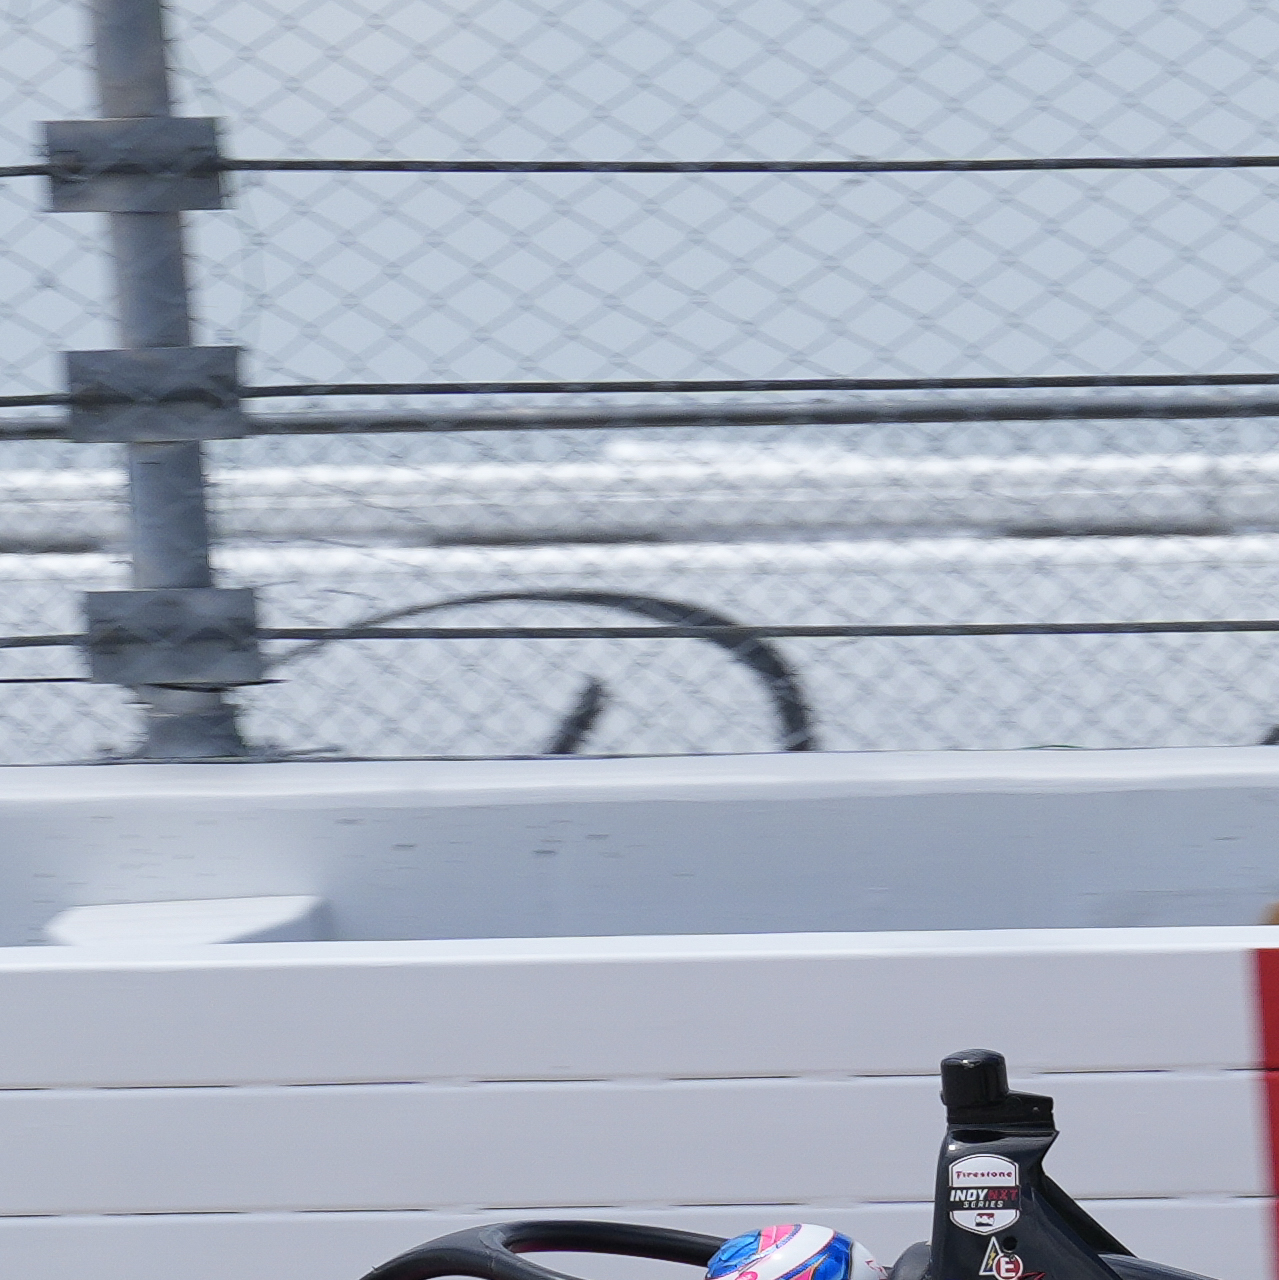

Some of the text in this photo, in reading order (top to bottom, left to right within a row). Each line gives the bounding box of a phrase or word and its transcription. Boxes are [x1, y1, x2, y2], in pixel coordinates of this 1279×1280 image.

[955, 1170, 1013, 1180] Firestone
[949, 1188, 988, 1202] INDY
[963, 1200, 1004, 1208] SERIES
